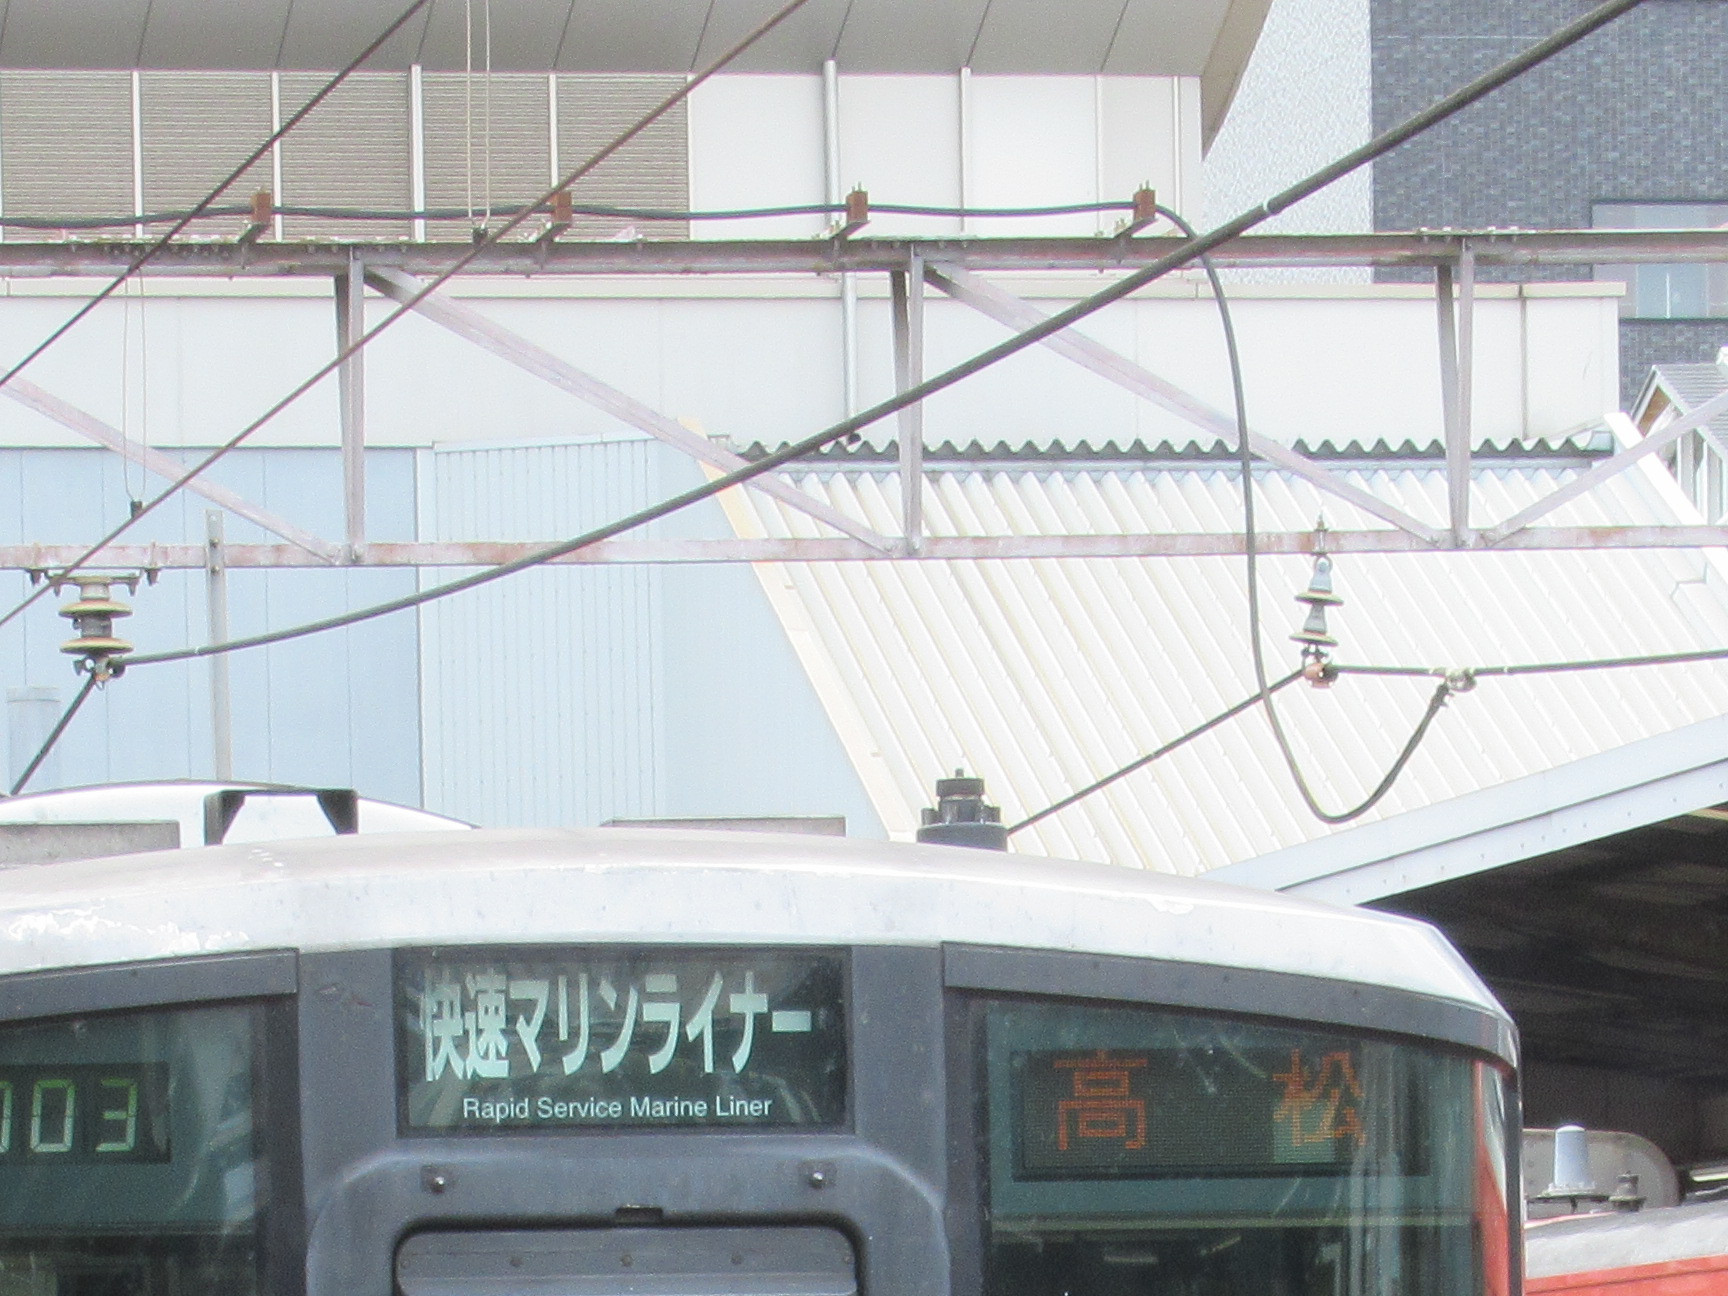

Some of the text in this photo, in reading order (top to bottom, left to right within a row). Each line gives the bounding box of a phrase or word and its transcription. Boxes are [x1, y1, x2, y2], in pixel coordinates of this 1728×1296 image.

[420, 971, 812, 1082] 快速マリンライナー
[463, 1096, 773, 1121] Rapid Service Marine Liner
[1053, 1048, 1366, 1152] 高松
